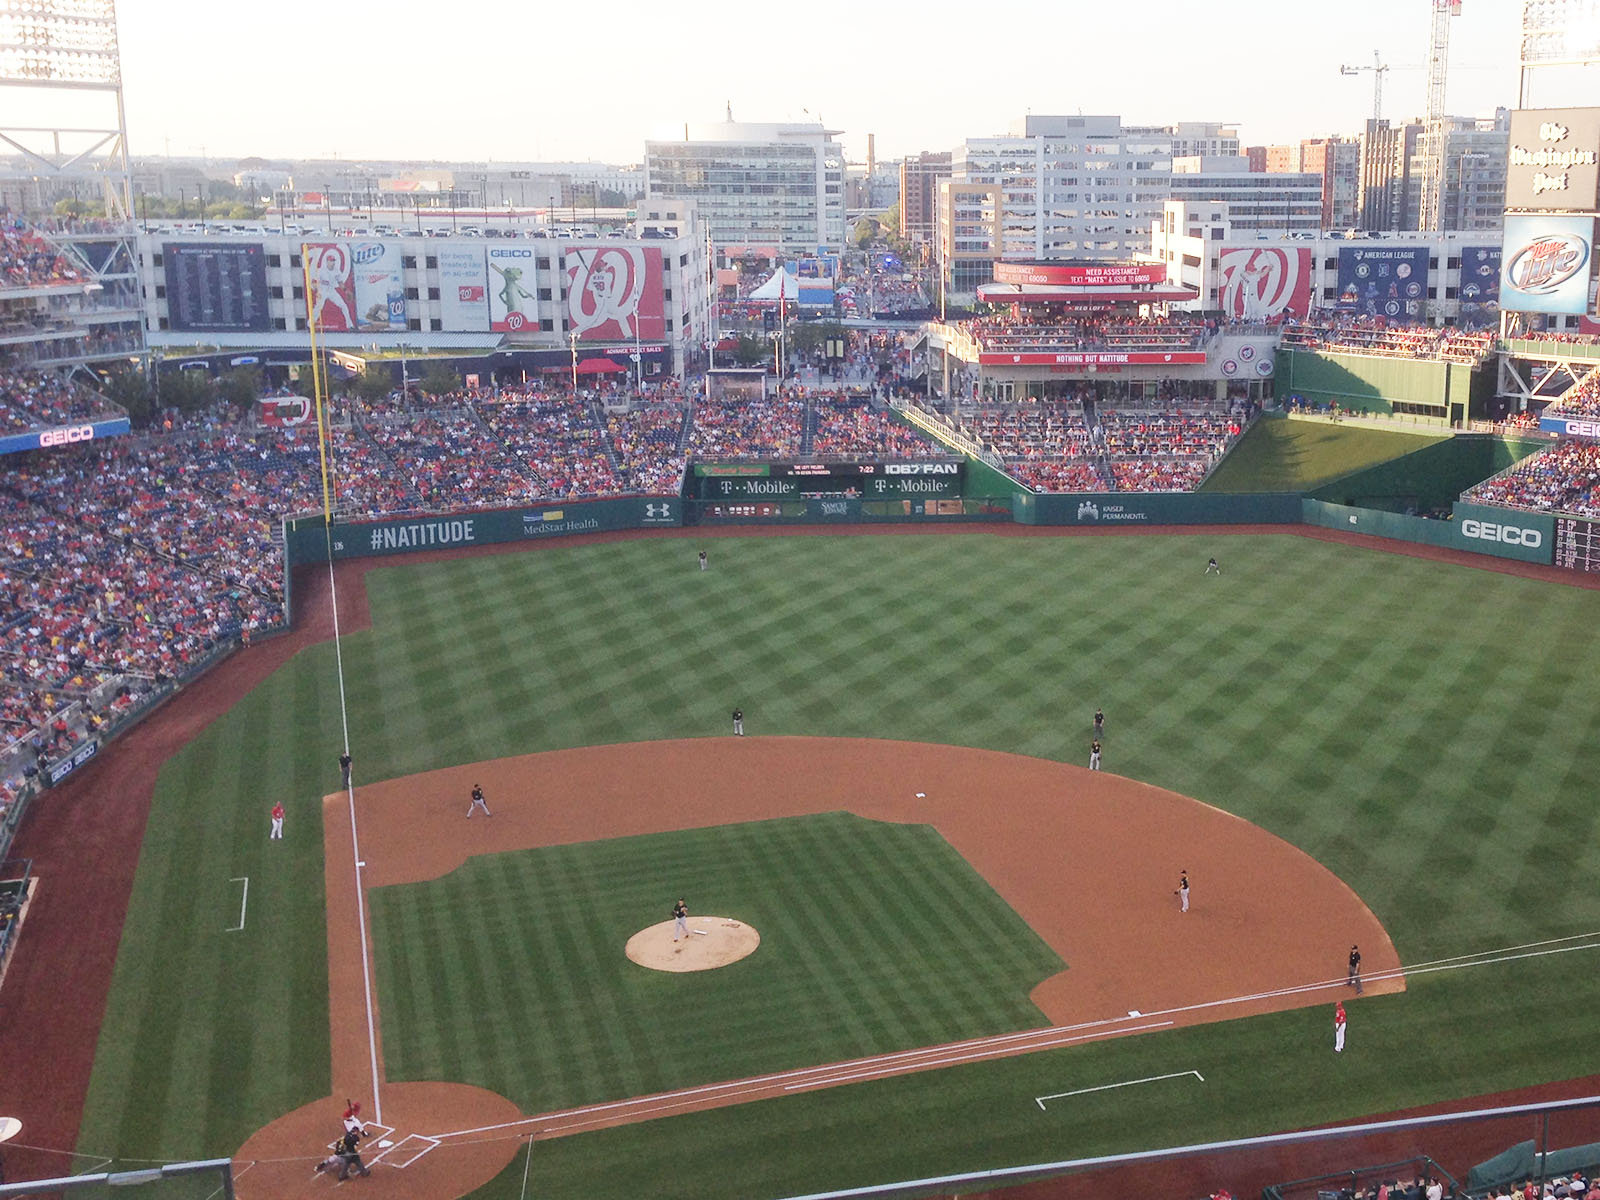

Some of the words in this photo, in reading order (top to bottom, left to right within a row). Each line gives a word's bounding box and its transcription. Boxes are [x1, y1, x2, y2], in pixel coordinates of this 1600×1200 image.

[1539, 122, 1569, 143] The
[1509, 145, 1597, 169] Washington
[1532, 173, 1569, 195] Post
[490, 249, 532, 258] GEICO
[1103, 267, 1140, 275] ASSISTANCE?
[39, 425, 94, 447] GEICO
[858, 465, 874, 473] 7:22
[923, 464, 958, 474] FAN
[1102, 505, 1125, 513] KAISER
[1102, 512, 1146, 520] PERMANENTE
[370, 519, 475, 551] #NATITUDE
[523, 522, 565, 535] MedStar
[566, 518, 599, 532] Health
[1461, 519, 1542, 548] GEICO
[51, 761, 73, 782] GEICO
